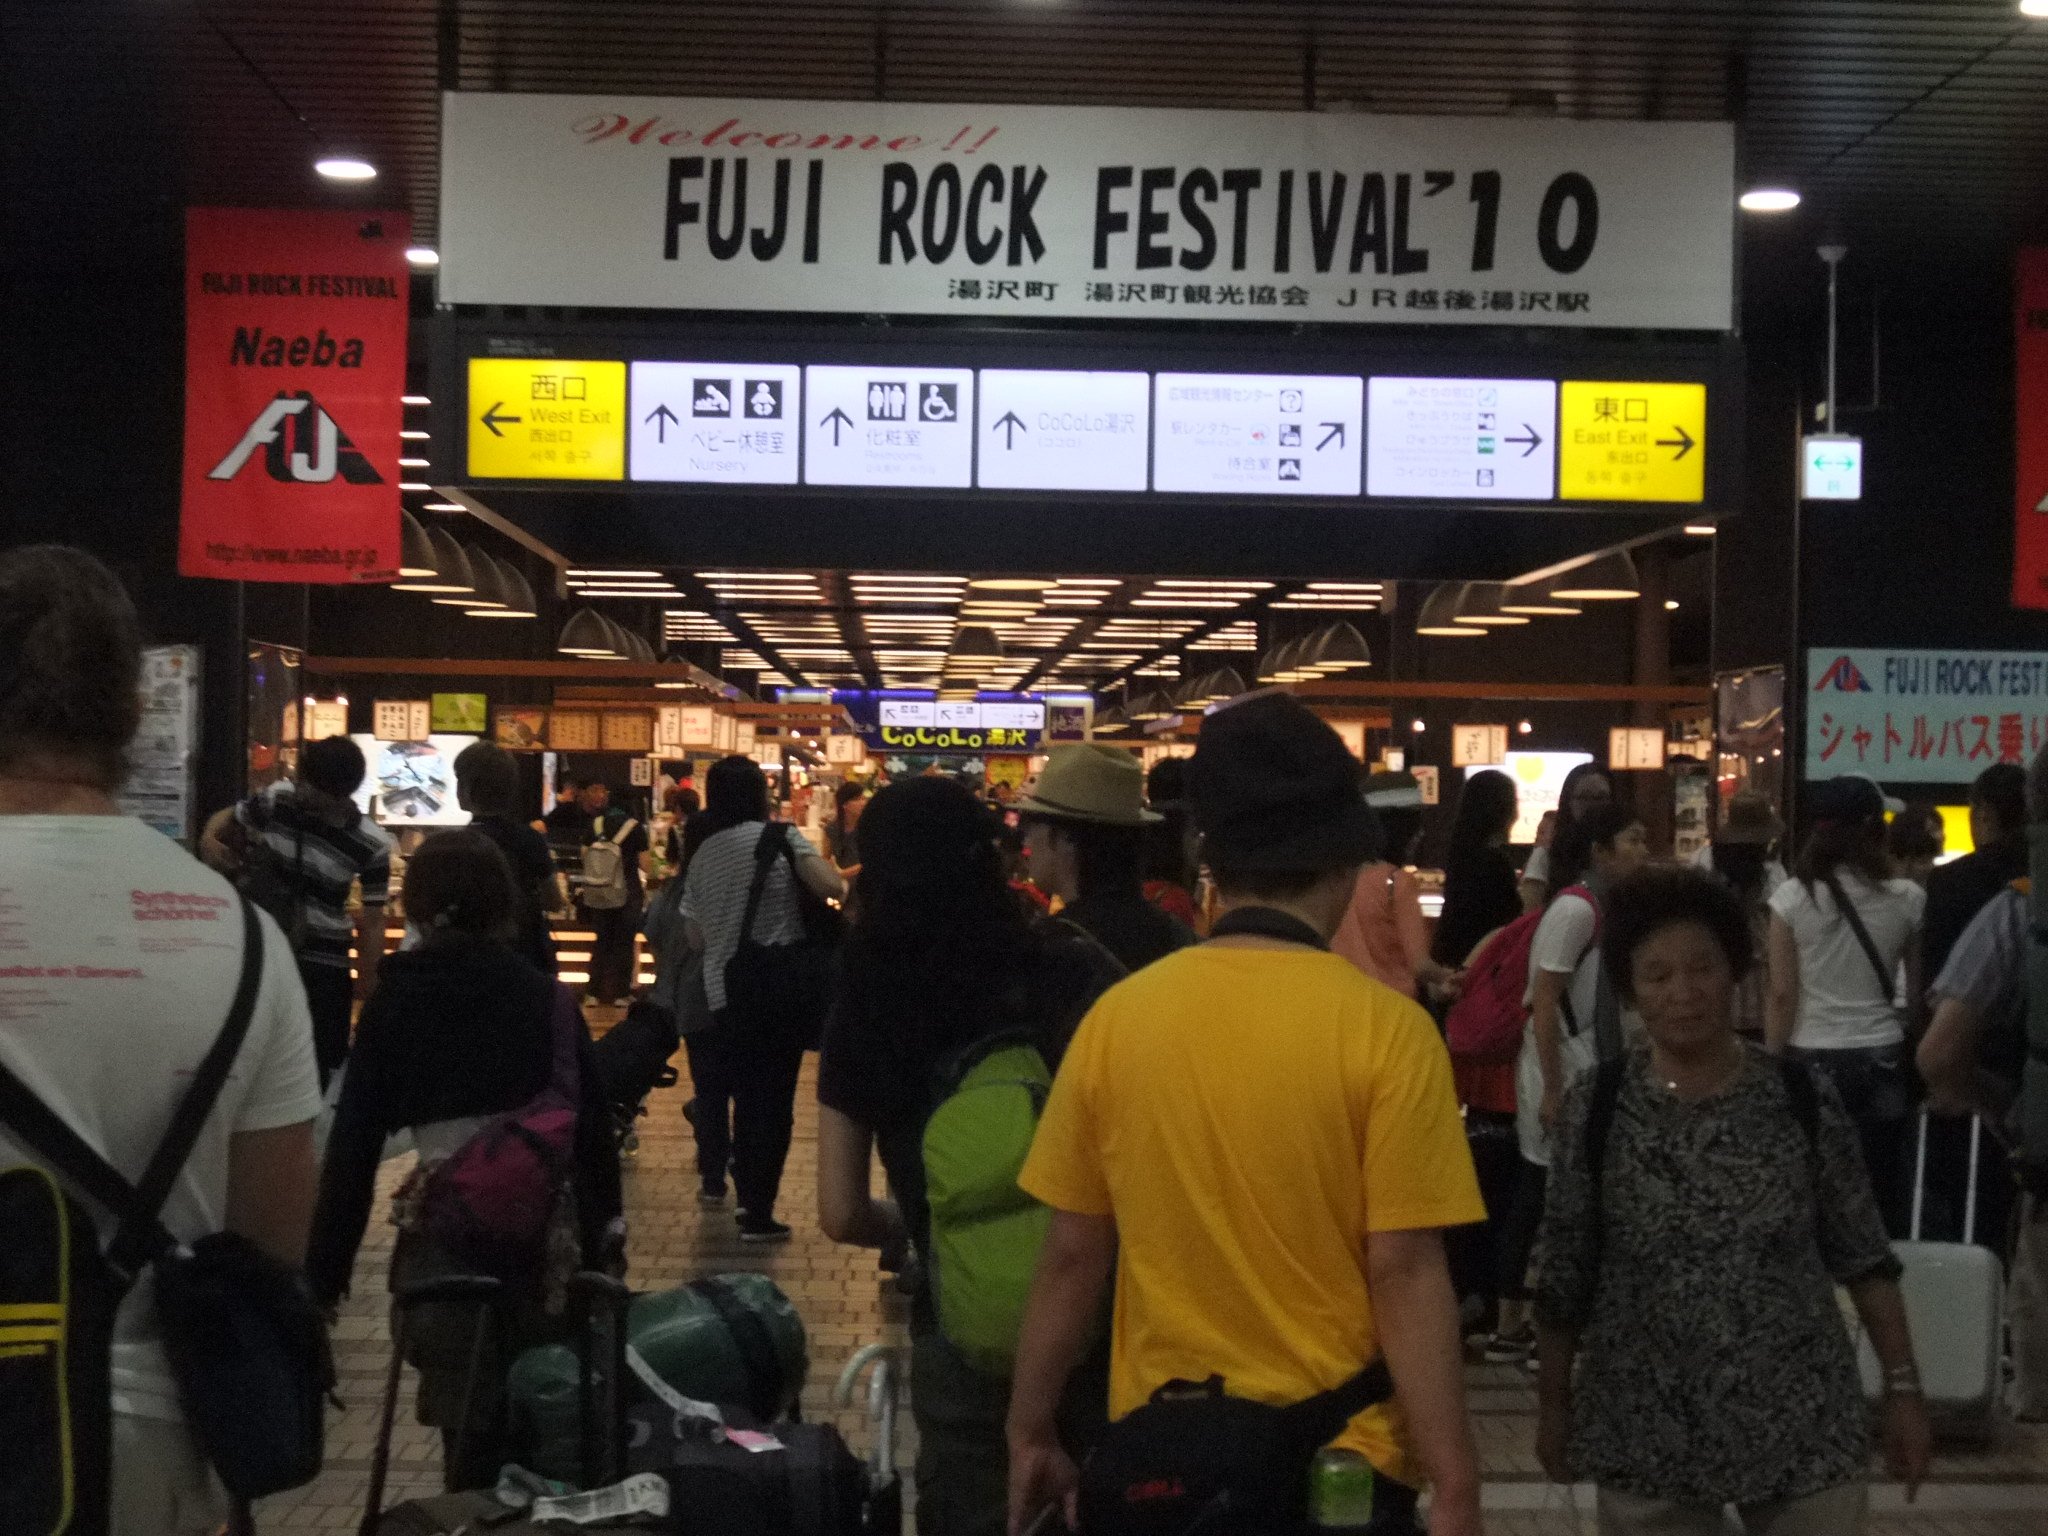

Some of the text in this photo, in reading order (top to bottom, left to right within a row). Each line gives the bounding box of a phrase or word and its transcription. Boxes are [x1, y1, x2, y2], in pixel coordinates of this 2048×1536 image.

[664, 156, 824, 264] FUJI
[878, 162, 1049, 266] ROCK
[307, 274, 399, 300] FESTIVAL
[947, 279, 1060, 301] 湯沢町
[230, 326, 365, 368] Naeba
[530, 374, 587, 401] 西口
[530, 408, 611, 424] West Exit
[1593, 396, 1648, 423] 東口
[1574, 428, 1648, 446] East Exit
[1885, 658, 1930, 695] FUJI
[1936, 659, 1993, 695] ROCK
